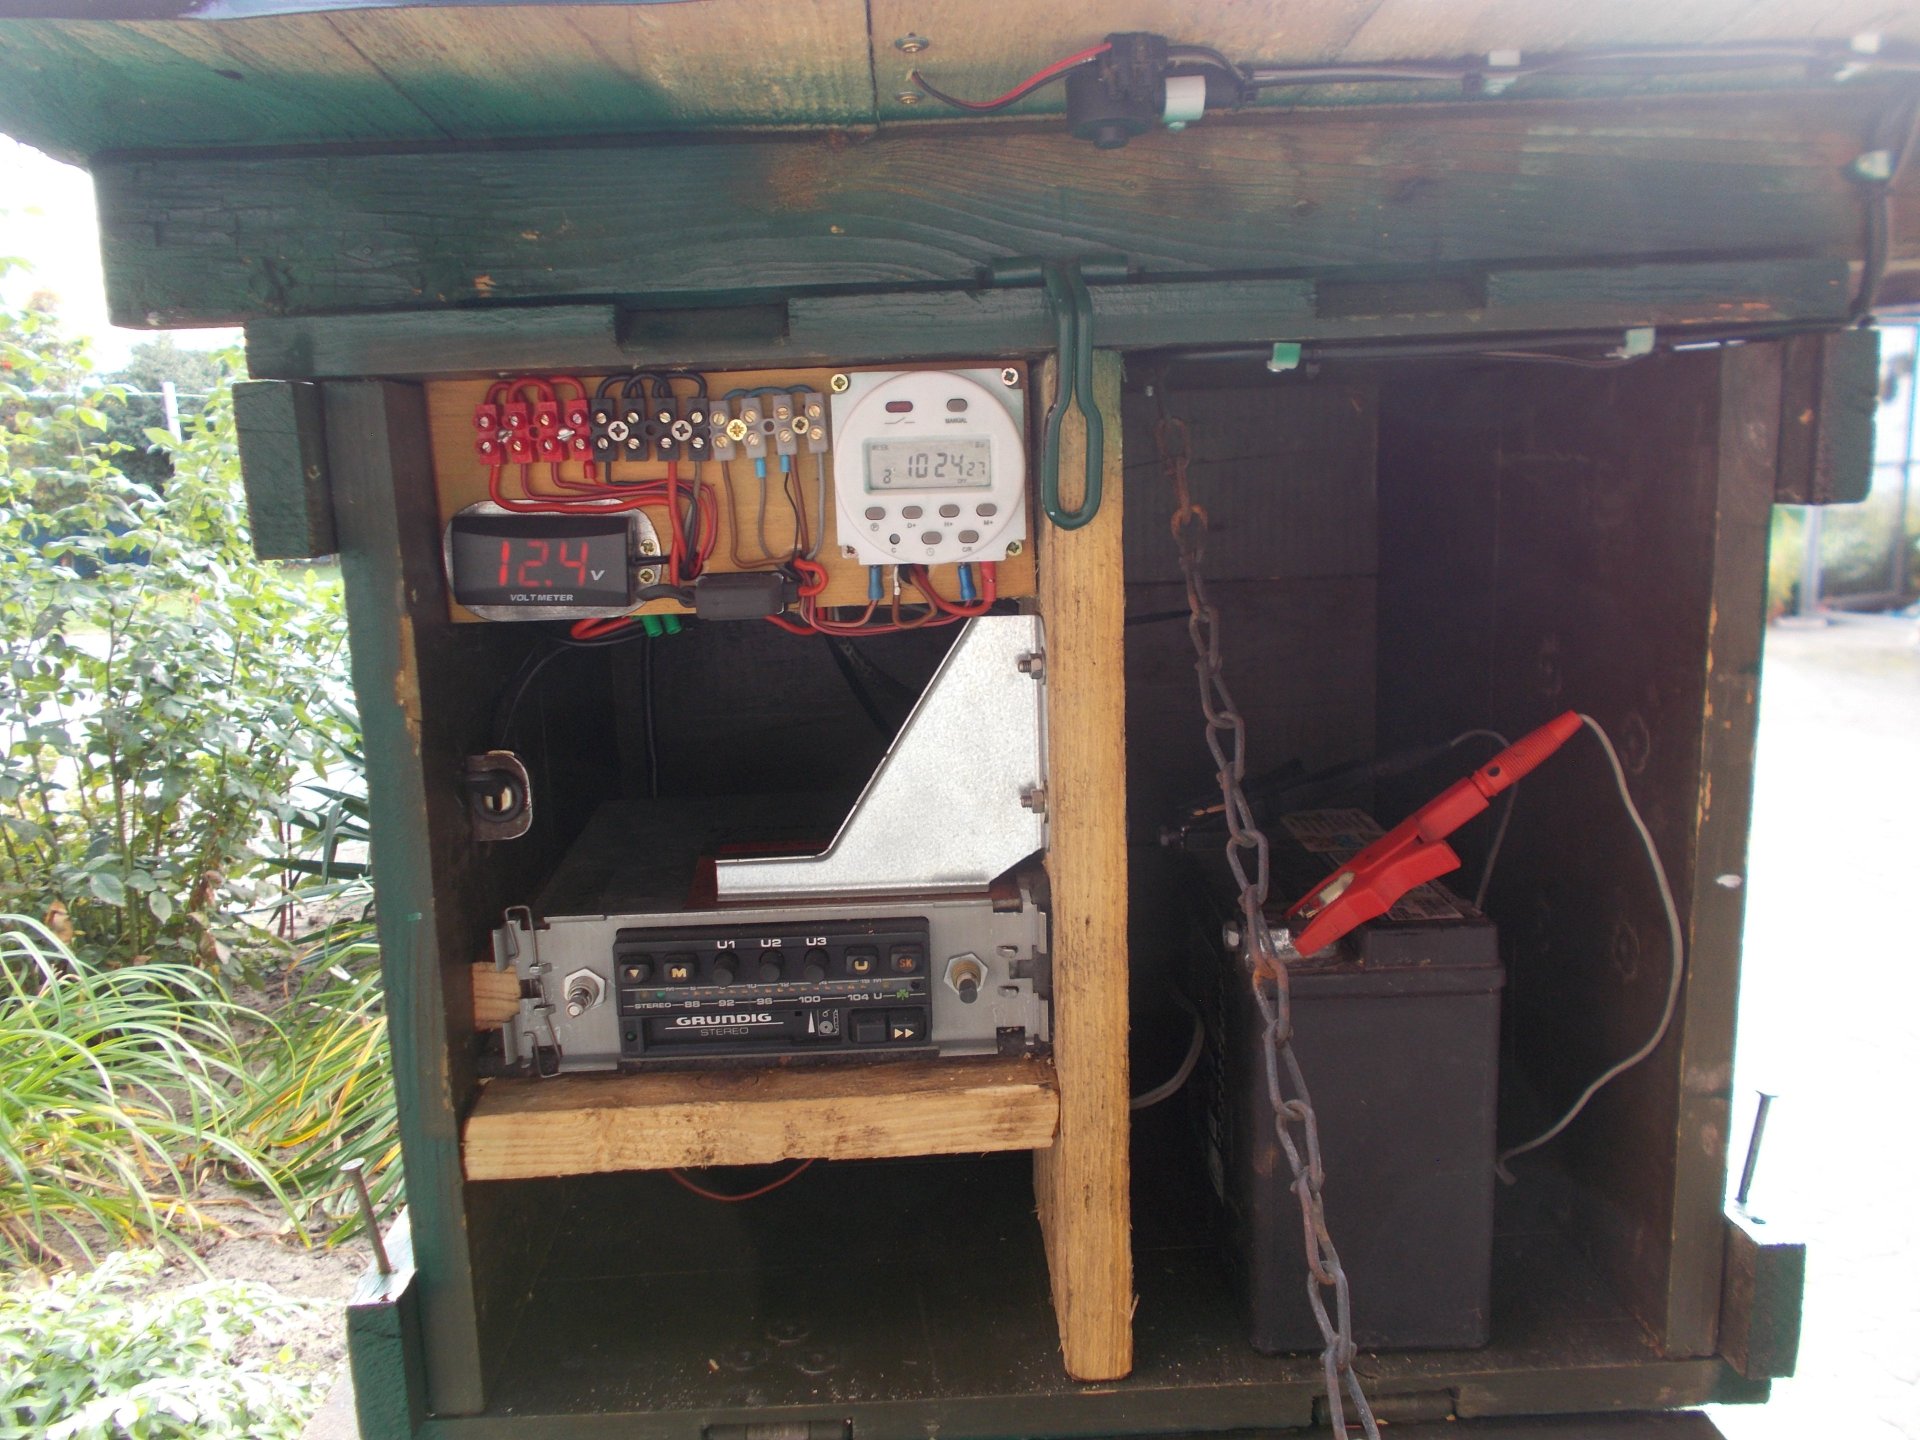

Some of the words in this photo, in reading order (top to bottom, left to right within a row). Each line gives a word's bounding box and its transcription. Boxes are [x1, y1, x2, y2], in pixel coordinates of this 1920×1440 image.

[716, 940, 736, 949] U1
[760, 938, 782, 948] U2
[805, 937, 827, 946] U3
[671, 967, 687, 978] M
[718, 999, 735, 1007] 92
[798, 995, 821, 1003] 100
[847, 993, 869, 1001] 104
[675, 1013, 772, 1026] GRUNDIG
[700, 1027, 749, 1037] STEREO
